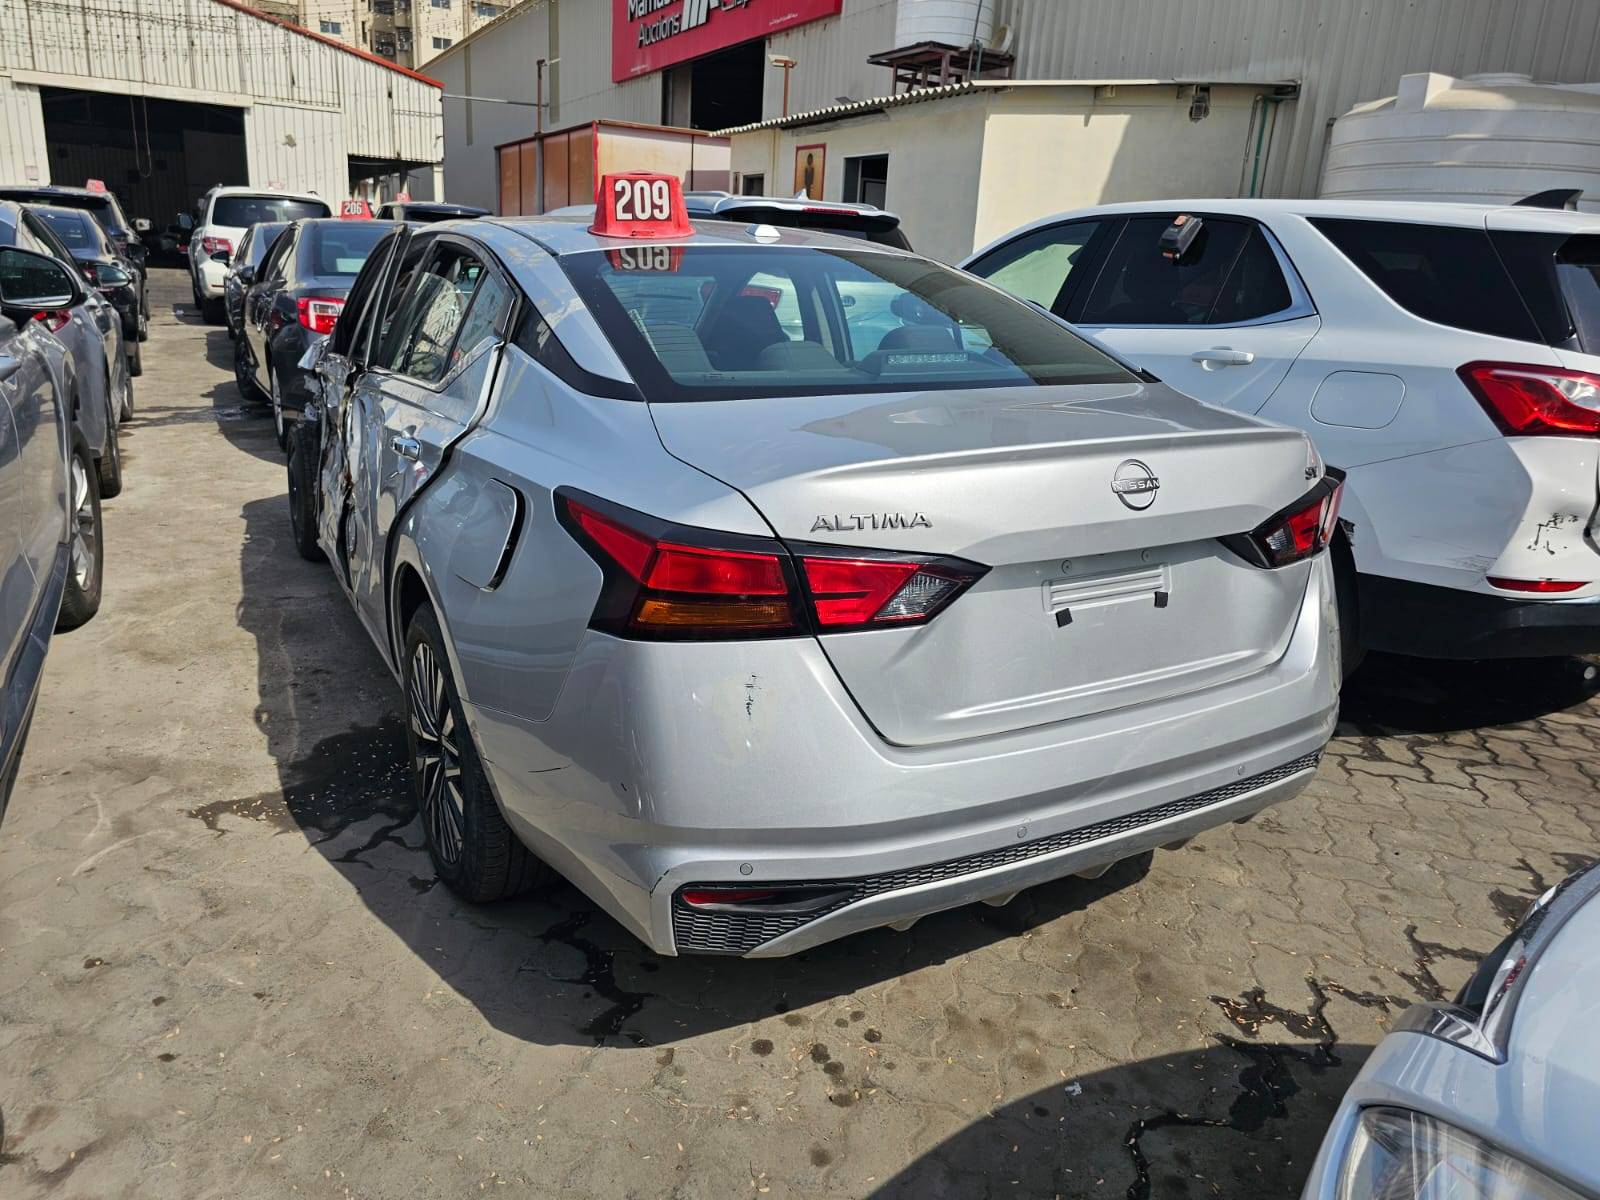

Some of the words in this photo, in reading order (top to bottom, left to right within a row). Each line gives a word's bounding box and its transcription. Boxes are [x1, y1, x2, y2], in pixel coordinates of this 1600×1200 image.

[638, 14, 680, 46] Auctions
[344, 202, 362, 215] 206
[614, 179, 670, 220] 209
[1111, 479, 1159, 492] NISSAN
[810, 511, 933, 533] ALTIMA
